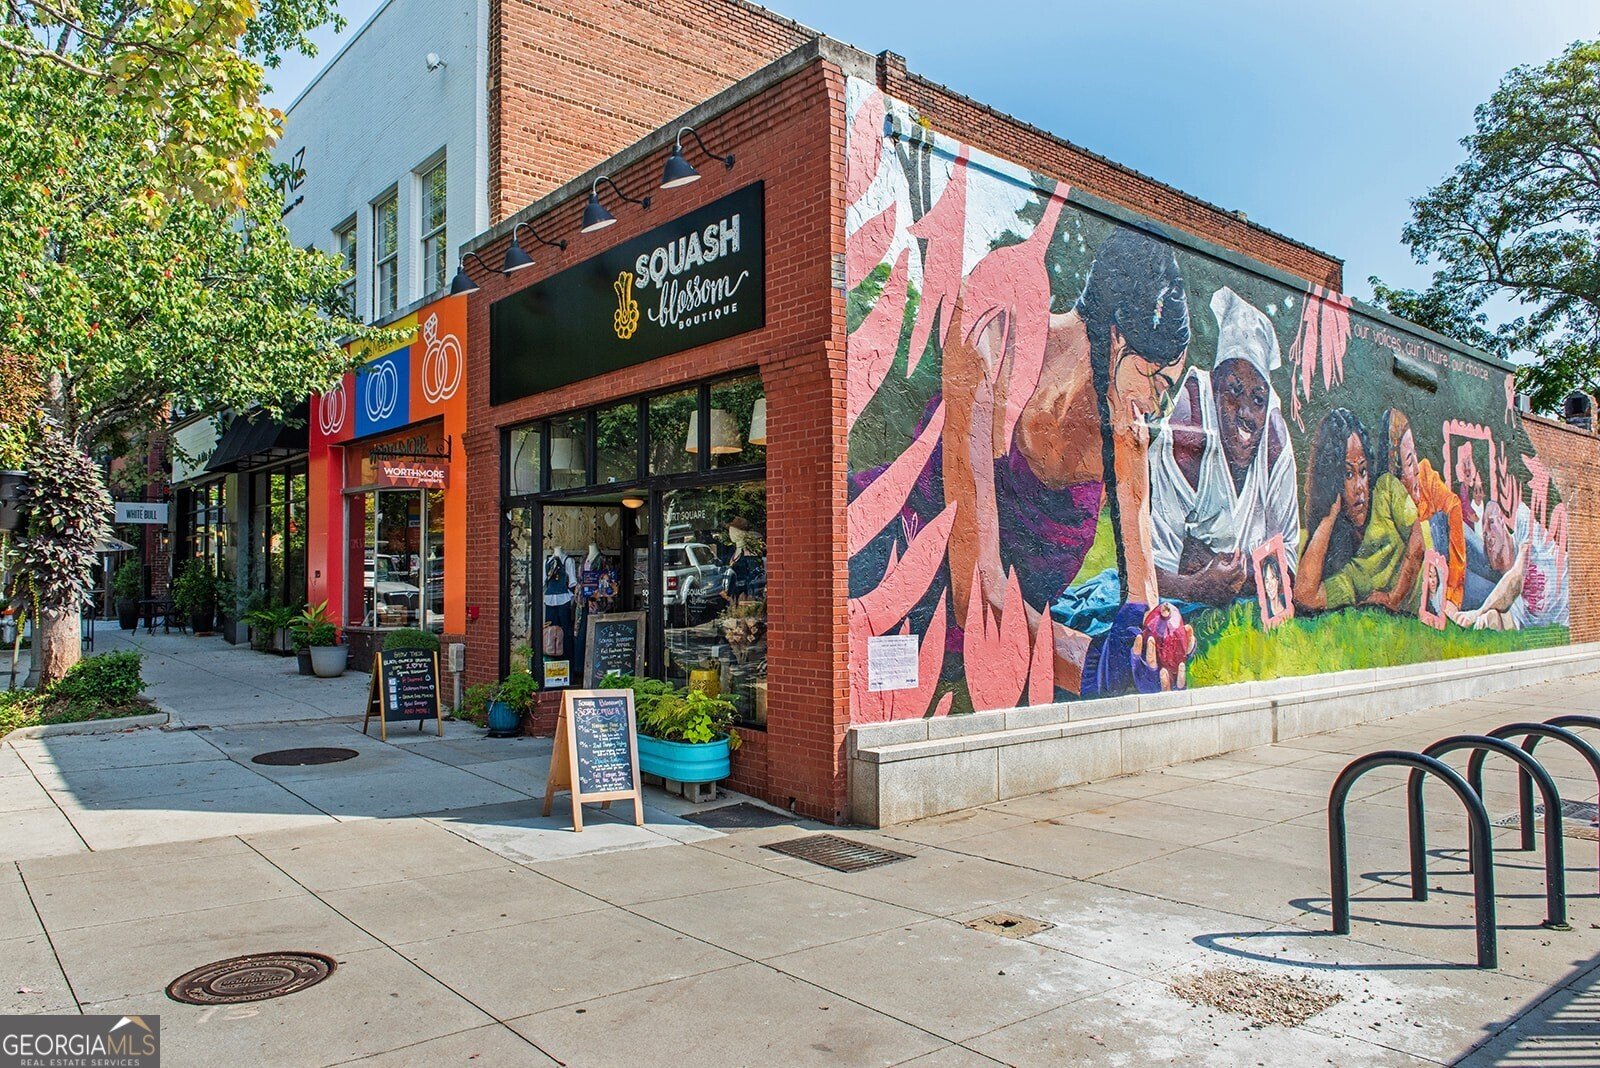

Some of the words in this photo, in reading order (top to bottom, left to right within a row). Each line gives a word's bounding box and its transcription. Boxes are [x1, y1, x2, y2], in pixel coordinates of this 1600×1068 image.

[635, 213, 740, 289] SQUASH
[647, 270, 749, 327] blossom
[678, 302, 738, 330] BOUTIQUE
[1353, 323, 1370, 340] our
[1405, 341, 1421, 358] our
[1452, 358, 1465, 372] our
[1465, 359, 1489, 381] choice
[384, 467, 445, 479] WORTHMORE
[126, 509, 143, 519] WHITE
[144, 510, 157, 520] BULL
[680, 510, 705, 520] SQUARE
[687, 588, 707, 597] SQUASH
